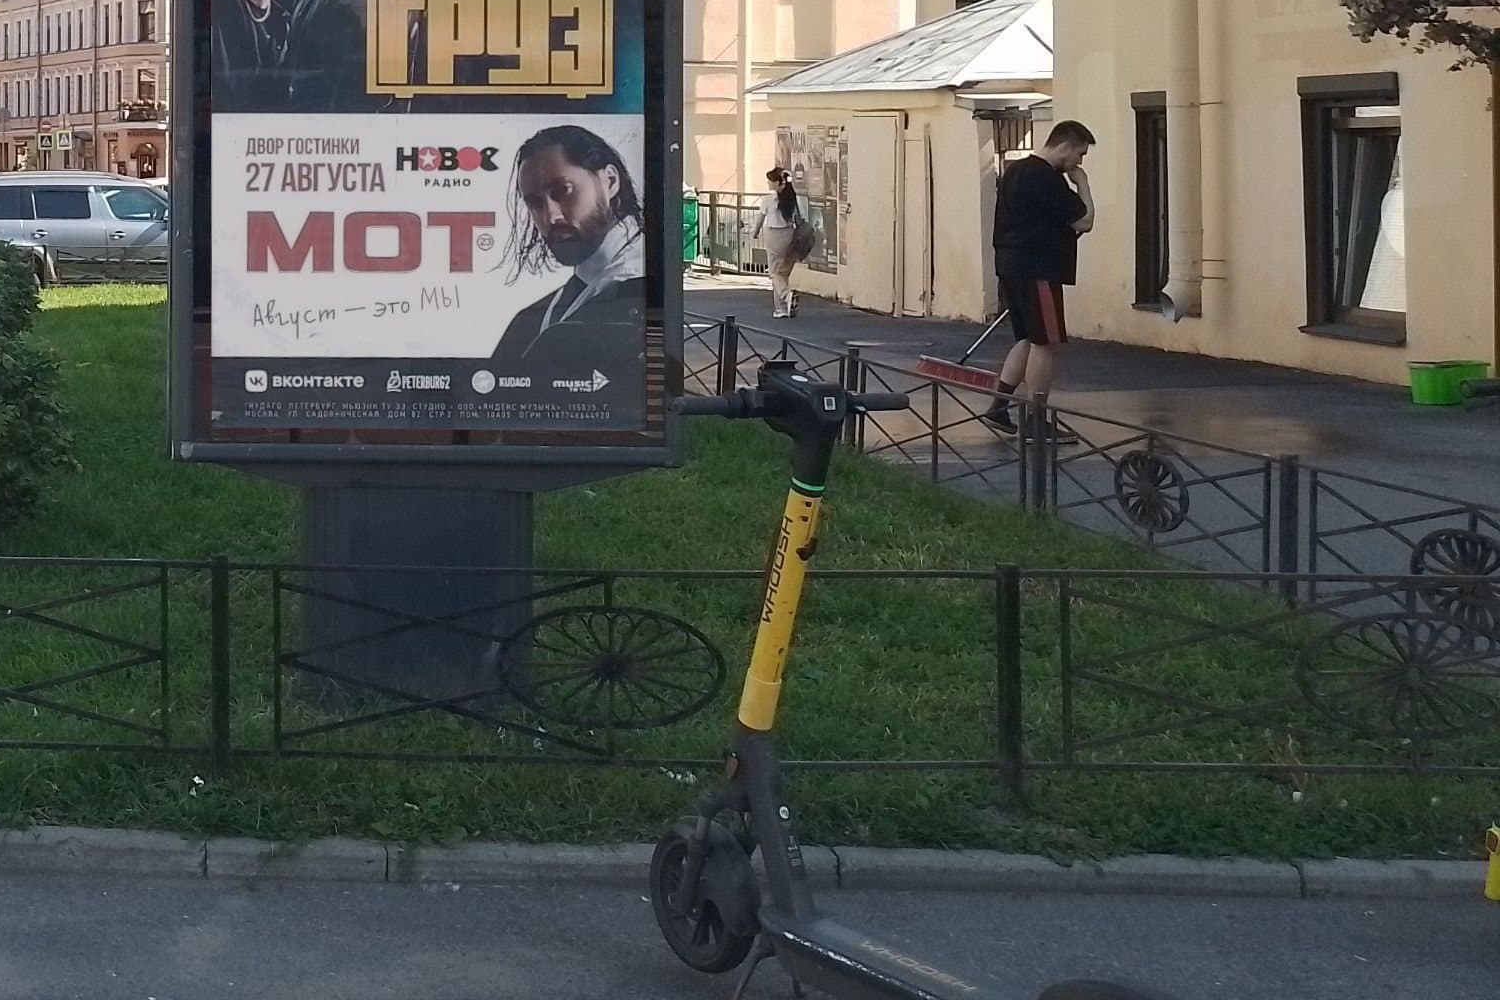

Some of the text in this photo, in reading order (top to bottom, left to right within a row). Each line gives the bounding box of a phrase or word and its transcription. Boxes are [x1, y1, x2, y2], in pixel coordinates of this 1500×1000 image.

[245, 138, 360, 156] ДВОР ГОСТИНКИ
[245, 163, 386, 192] 27 АВГУСТА
[424, 178, 472, 187] РАДИО
[245, 211, 496, 273] МОТ
[252, 299, 337, 338] Август
[372, 300, 411, 317] это
[420, 284, 461, 311] МЫ
[761, 515, 794, 623] WHOOSH
